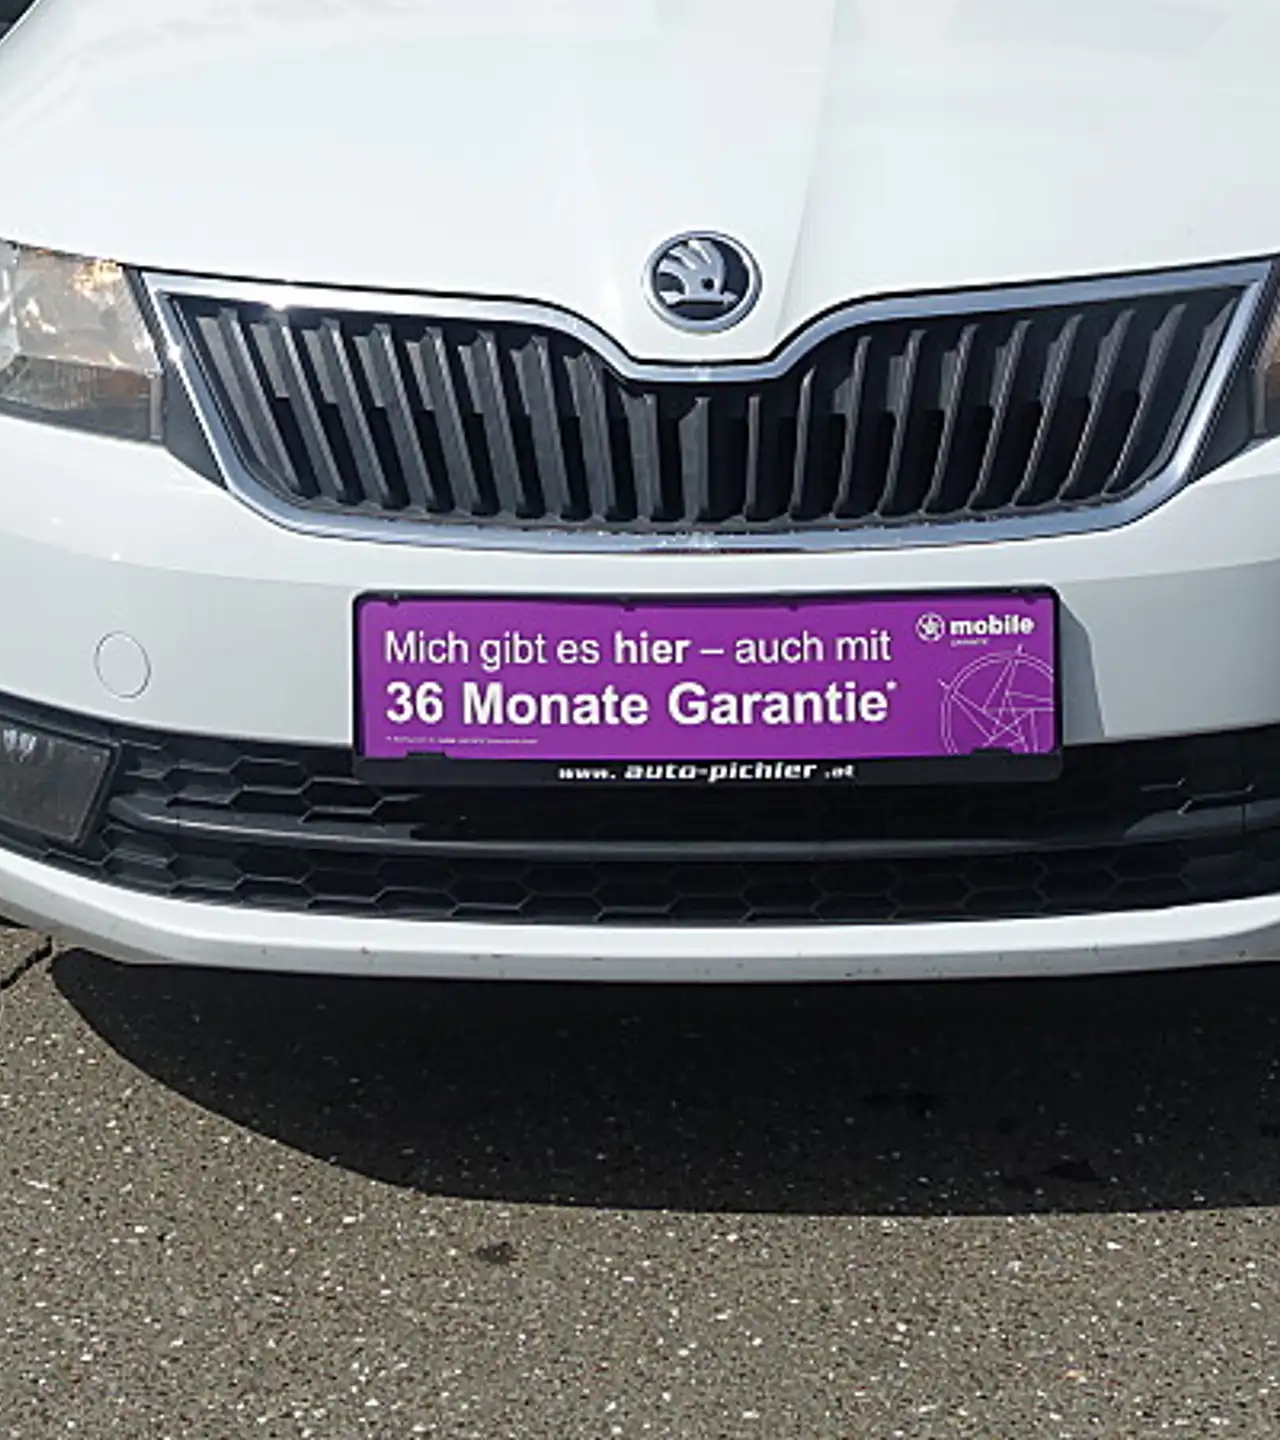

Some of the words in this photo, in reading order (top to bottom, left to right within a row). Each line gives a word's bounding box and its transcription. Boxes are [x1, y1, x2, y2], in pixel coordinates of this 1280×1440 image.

[949, 613, 1036, 636] mobile
[384, 629, 470, 664] Mich
[479, 630, 548, 673] gibt
[555, 638, 601, 664] es
[613, 630, 692, 664] hier
[734, 630, 824, 664] auch
[835, 629, 893, 662] mit
[385, 680, 445, 724] 36
[461, 681, 650, 726] Monate
[558, 766, 617, 780] www.
[623, 761, 818, 783] auto-pichler
